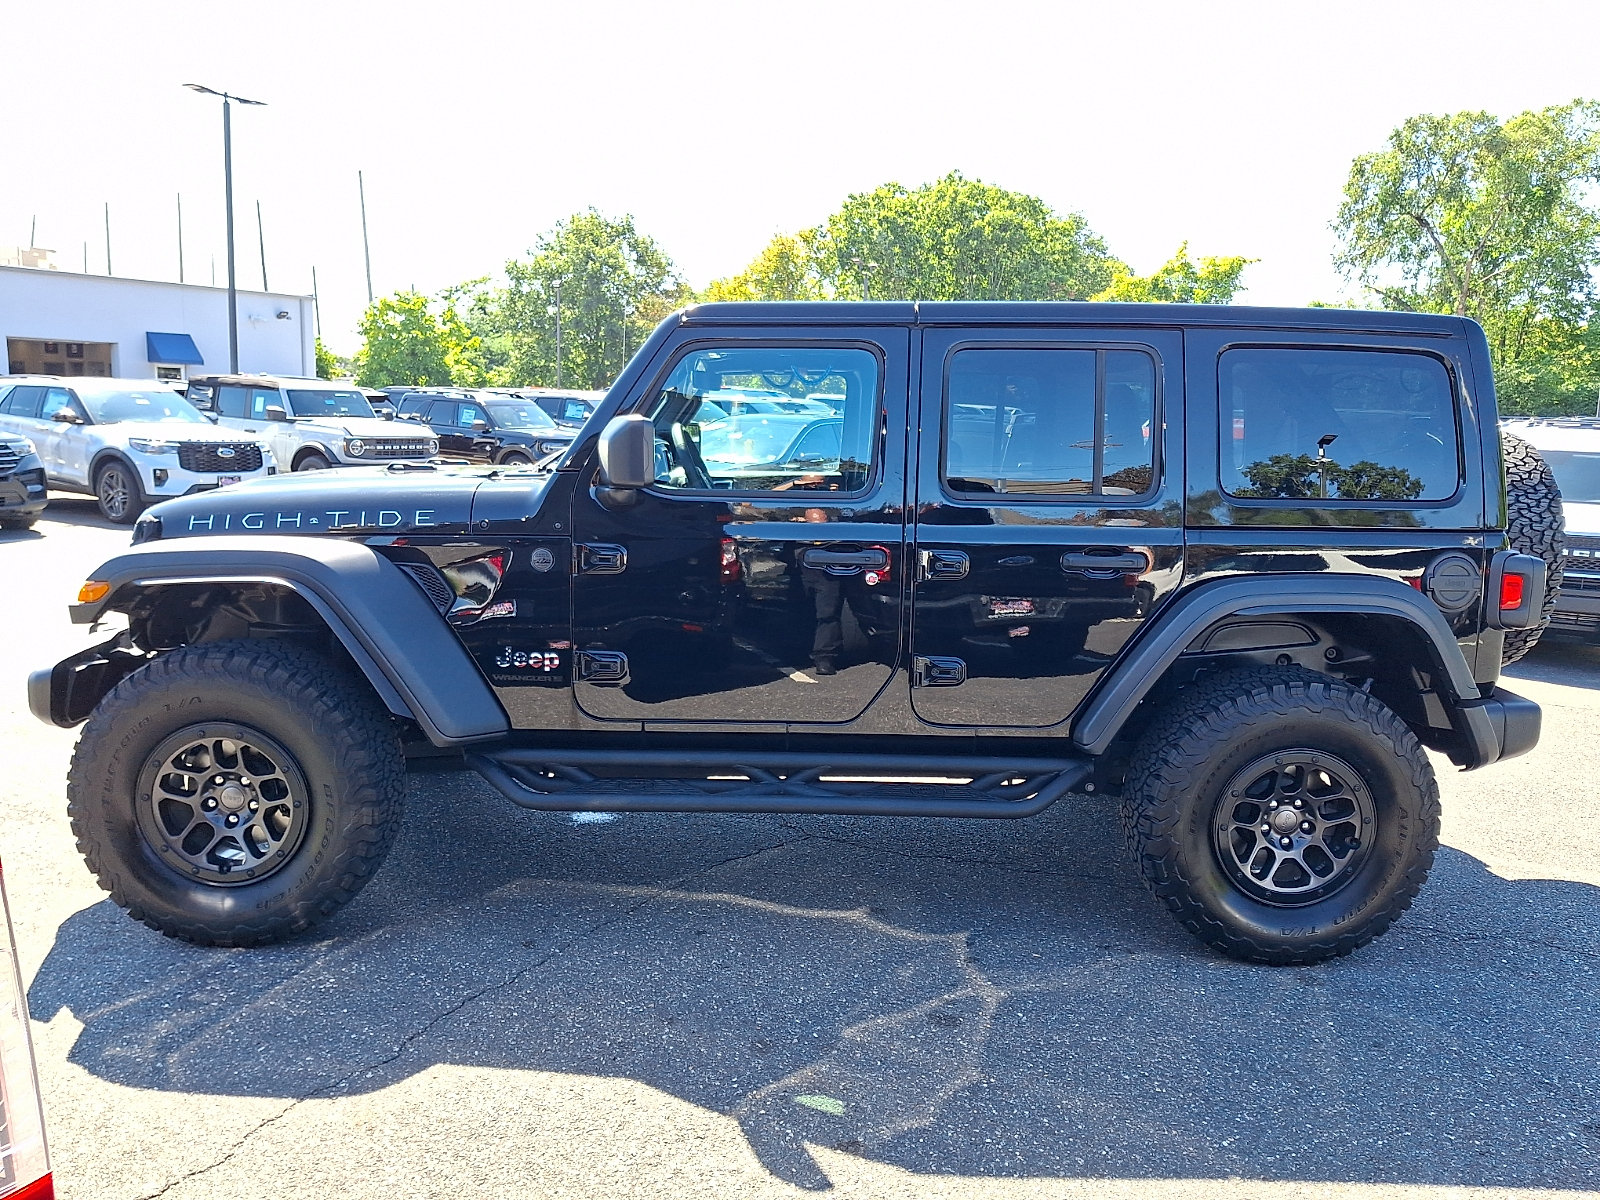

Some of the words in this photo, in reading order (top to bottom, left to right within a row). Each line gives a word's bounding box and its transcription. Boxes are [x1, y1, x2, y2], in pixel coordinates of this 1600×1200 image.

[188, 512, 302, 530] HIGH
[325, 510, 435, 527] TIDE
[496, 646, 560, 672] Jeep
